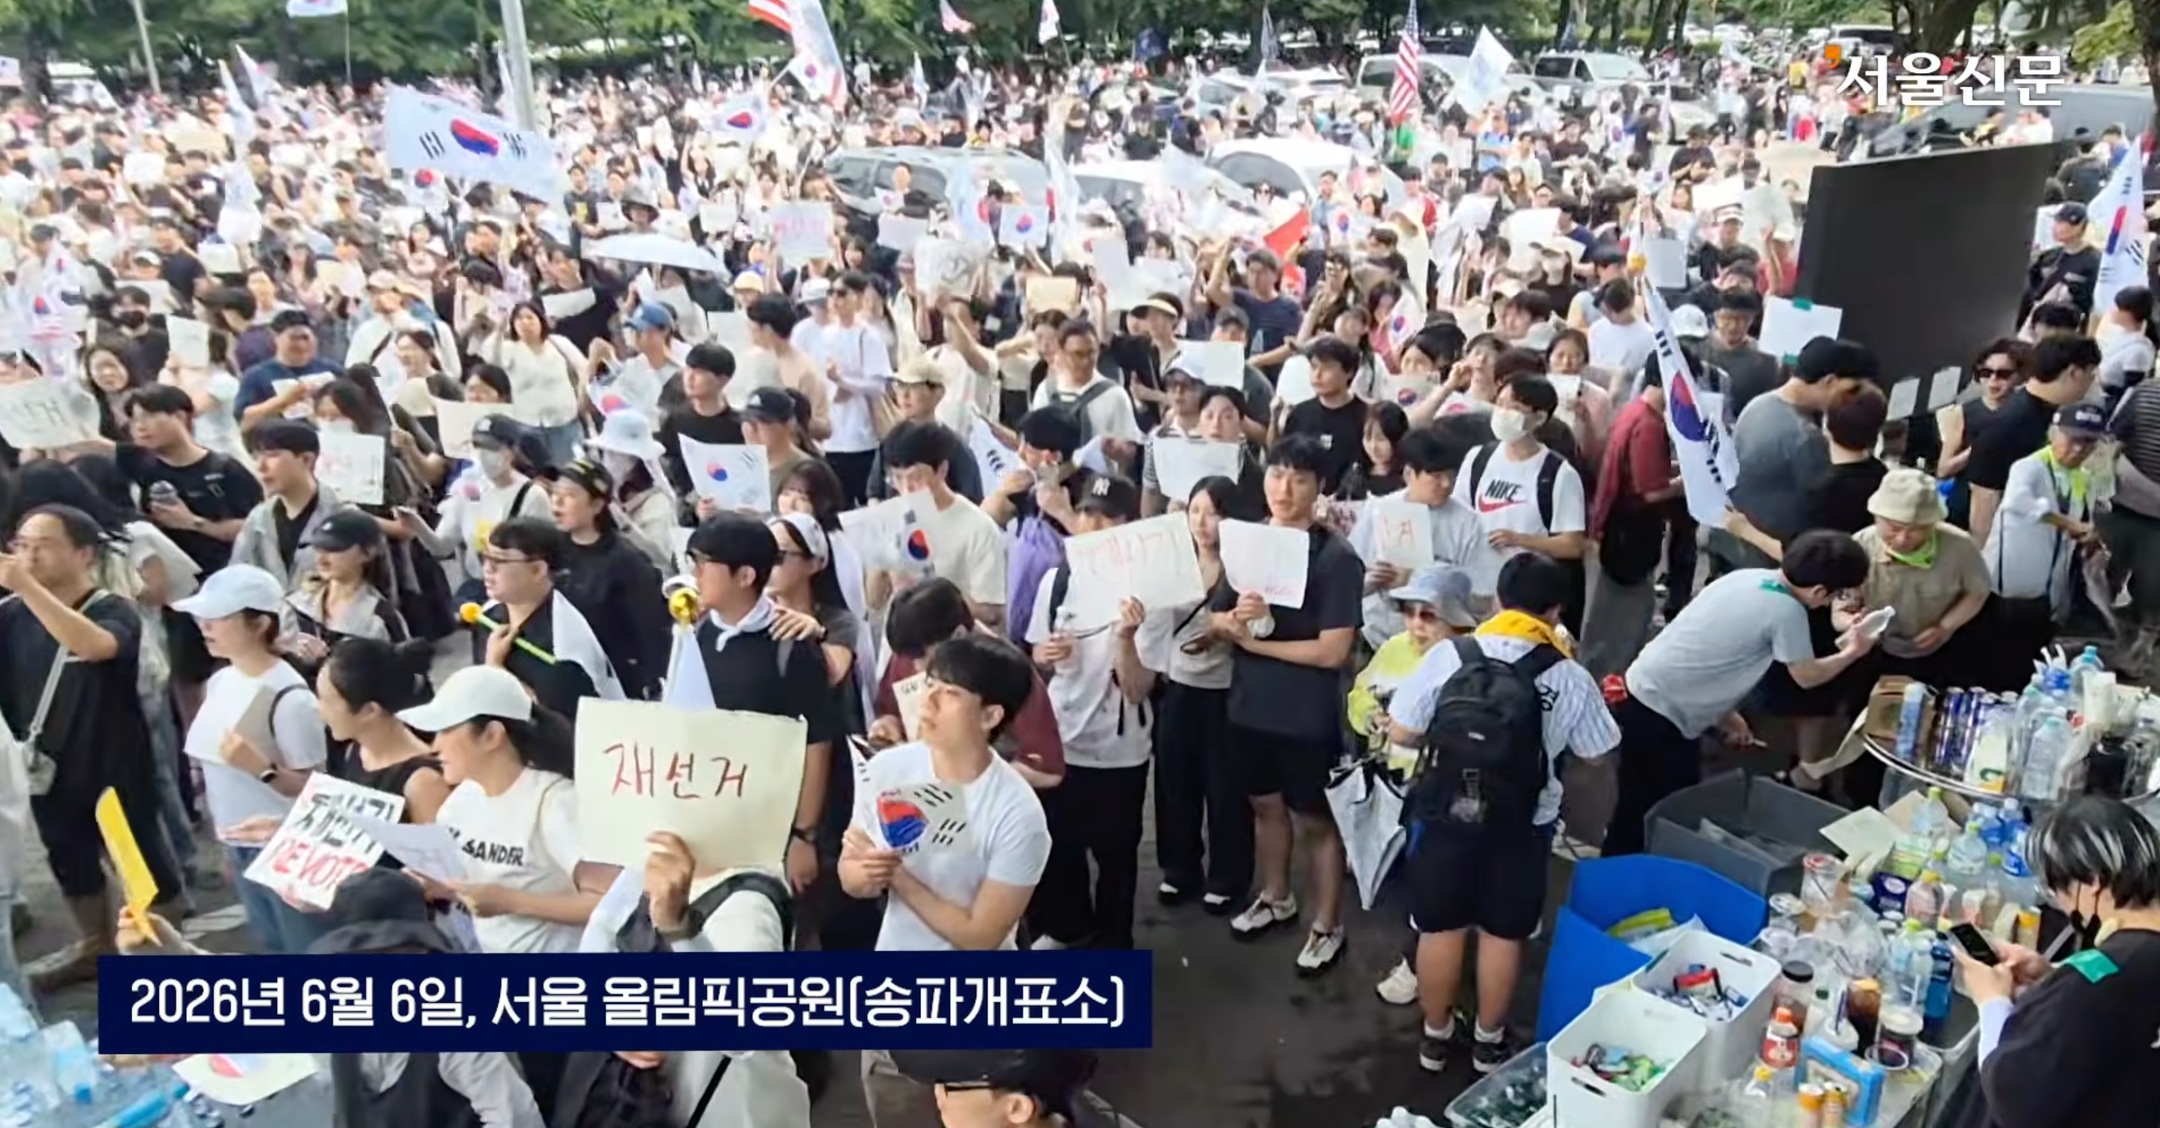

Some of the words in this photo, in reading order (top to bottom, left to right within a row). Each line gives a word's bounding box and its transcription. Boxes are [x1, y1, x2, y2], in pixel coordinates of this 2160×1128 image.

[1484, 479, 1524, 502] NIKE
[603, 740, 748, 799] 재선거
[461, 839, 524, 868] SANDER
